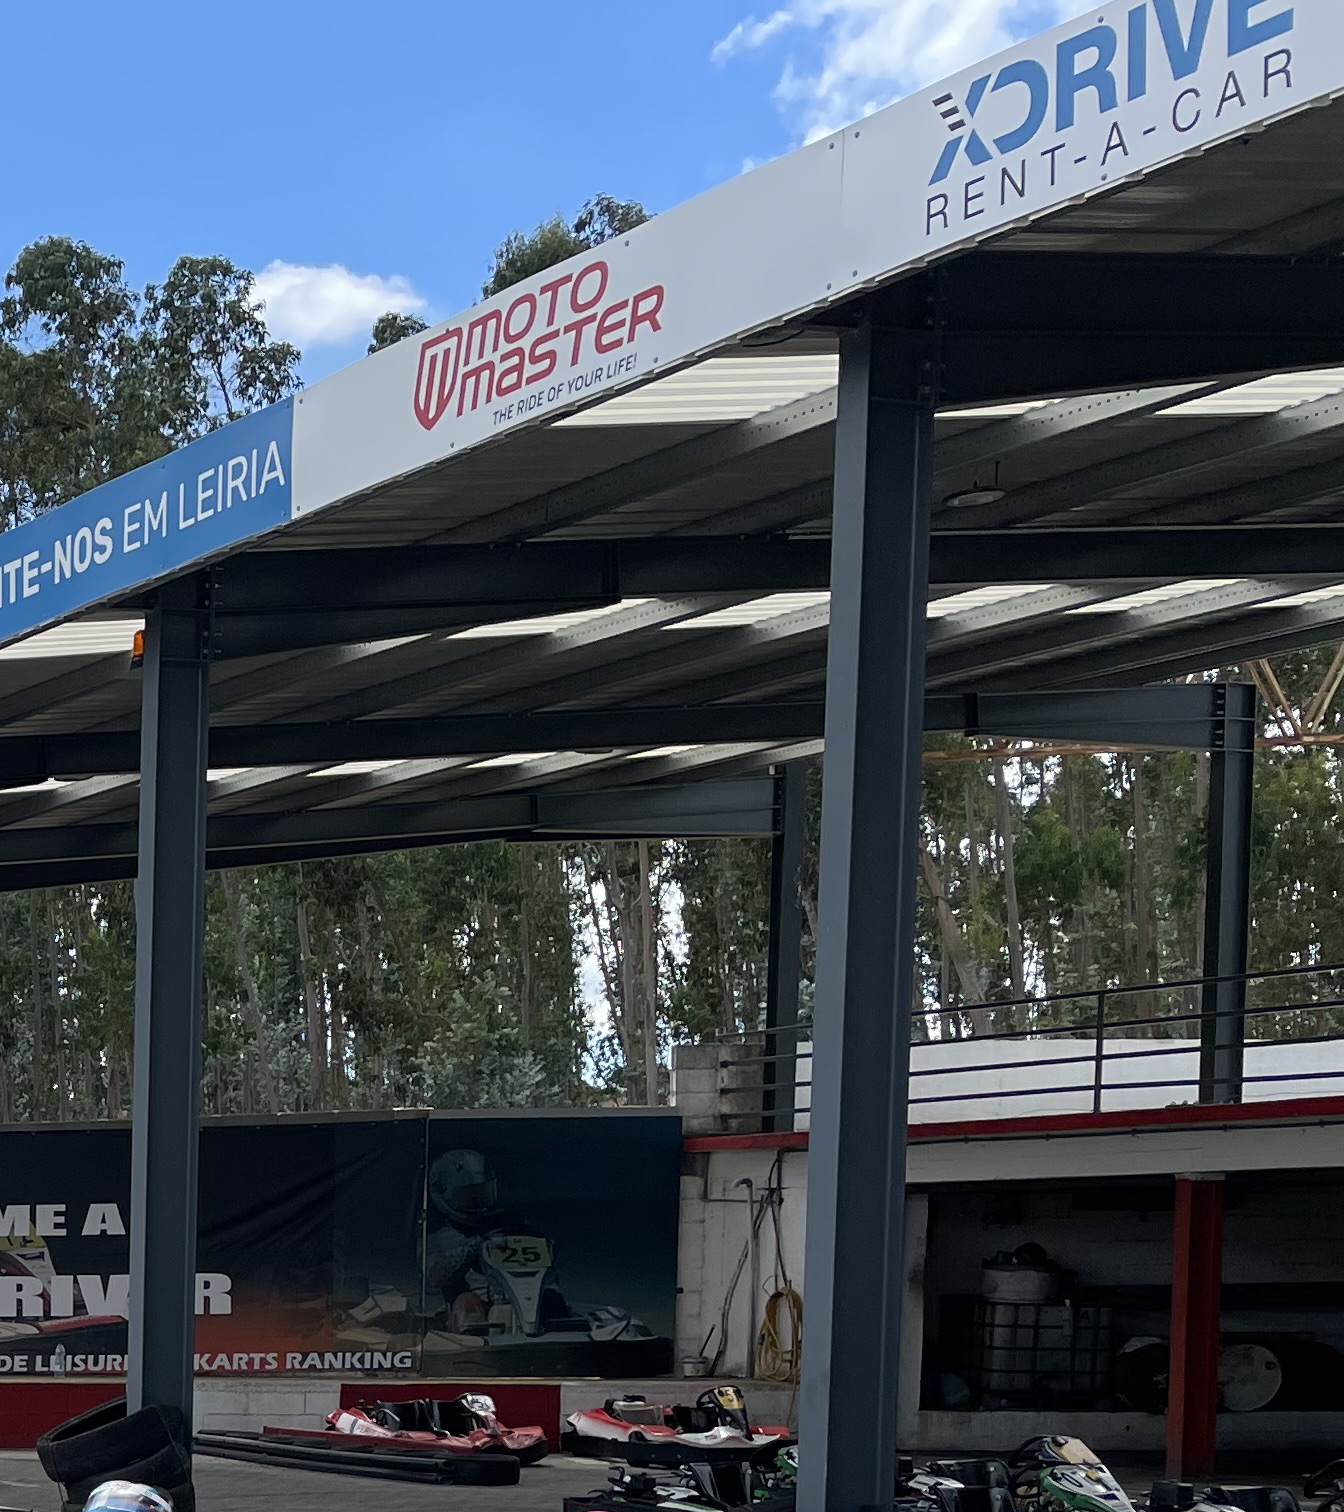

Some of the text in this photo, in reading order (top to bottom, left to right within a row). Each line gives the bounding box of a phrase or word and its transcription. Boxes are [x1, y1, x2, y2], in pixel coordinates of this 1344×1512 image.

[928, 0, 1293, 186] XDRIVE
[926, 48, 1292, 236] RENT-A-CAR
[492, 353, 637, 426] THE RIDE OF YOUR LIFE!
[123, 492, 167, 553] EM
[179, 441, 286, 530] LEIRIA
[82, 1203, 126, 1236] A
[502, 1247, 541, 1263] 25
[193, 1352, 278, 1371] KARTS
[285, 1351, 412, 1370] RANKING
